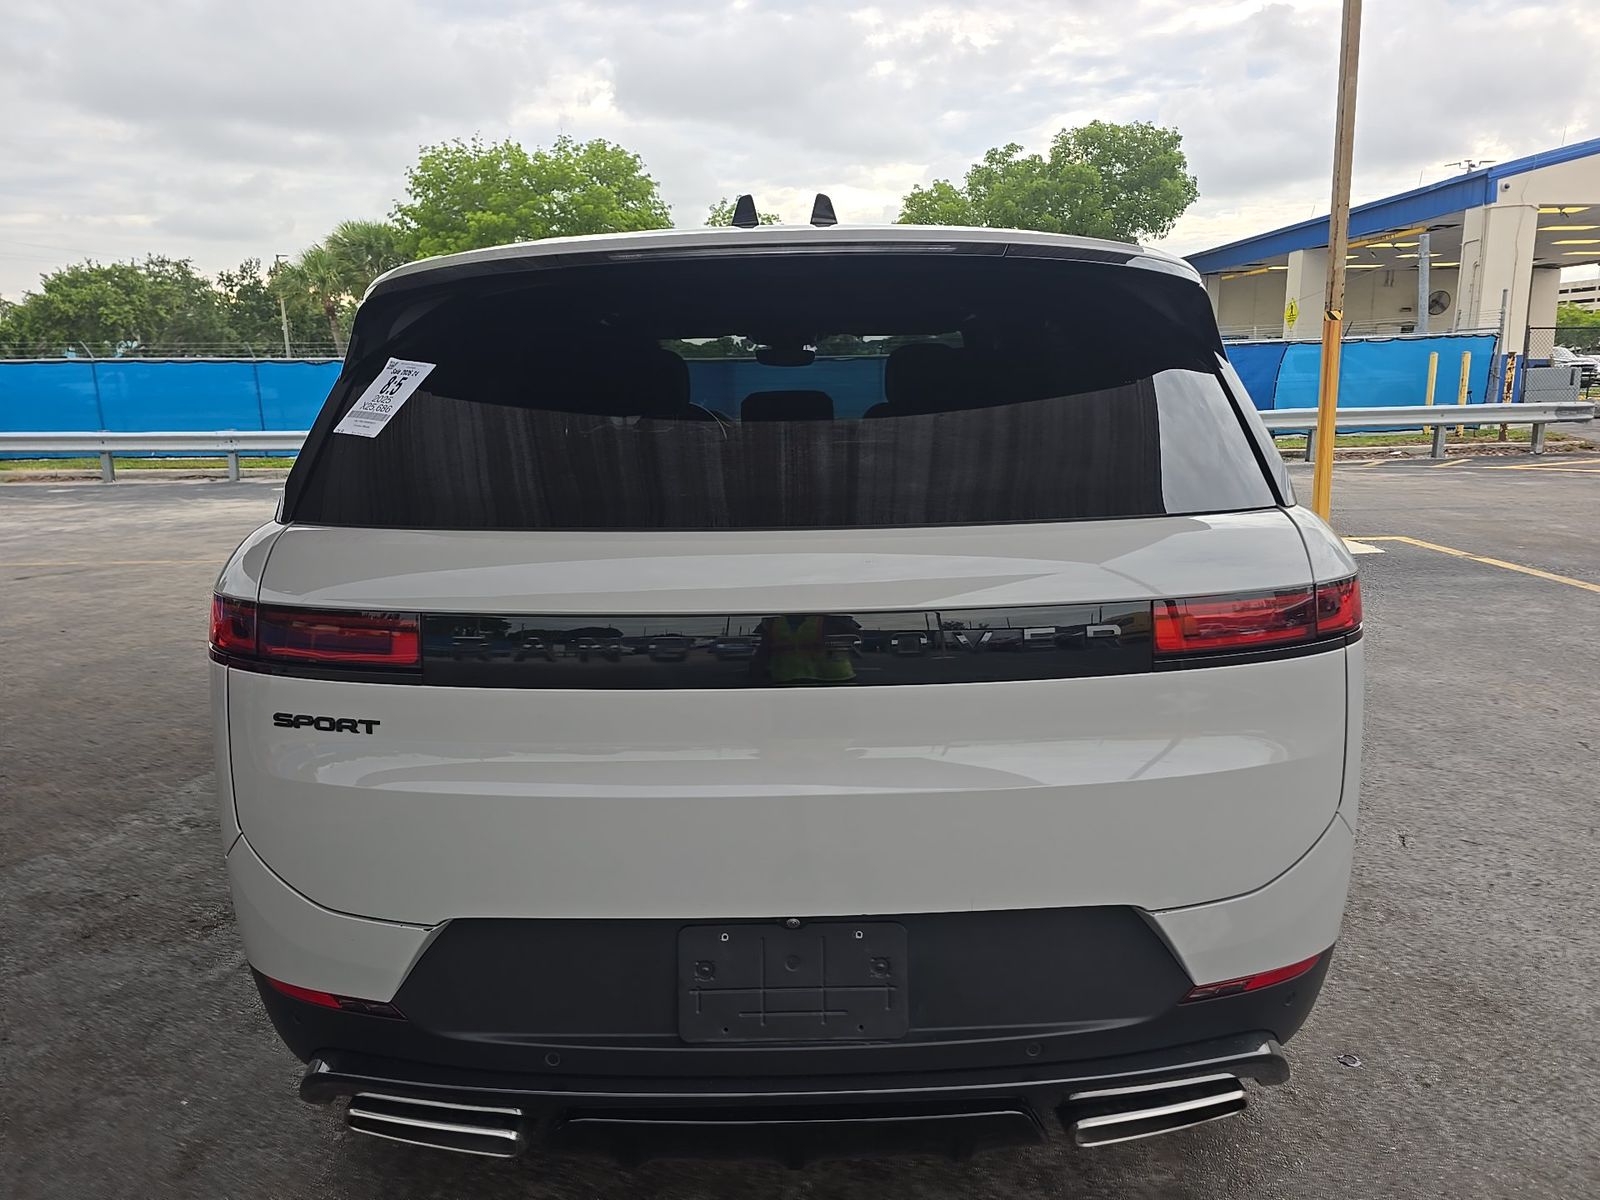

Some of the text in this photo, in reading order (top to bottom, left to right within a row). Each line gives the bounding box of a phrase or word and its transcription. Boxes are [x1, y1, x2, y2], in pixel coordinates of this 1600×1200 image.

[380, 376, 408, 395] 8:5
[372, 395, 393, 403] 2025
[824, 624, 1121, 659] ROVER
[273, 712, 381, 735] SPORT
